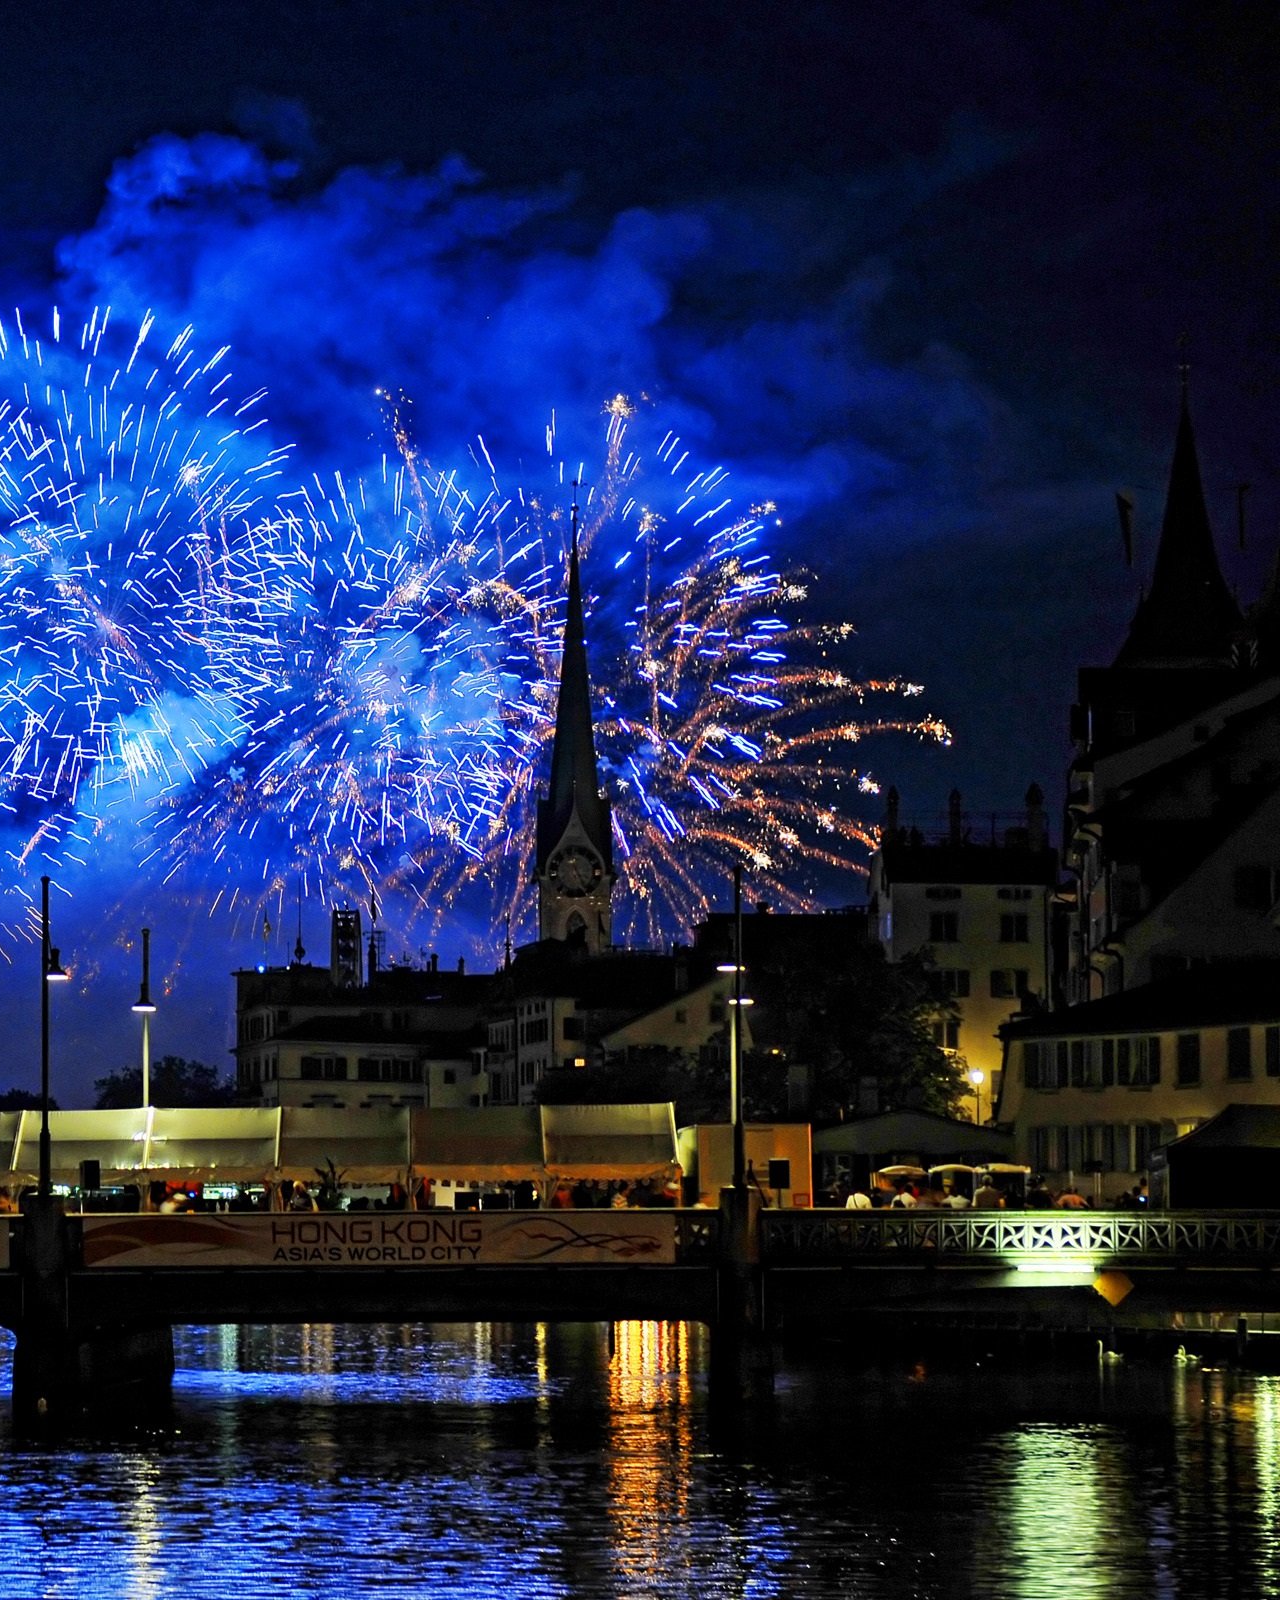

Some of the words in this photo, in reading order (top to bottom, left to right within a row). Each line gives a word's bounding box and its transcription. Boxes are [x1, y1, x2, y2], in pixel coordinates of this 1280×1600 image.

[273, 1221, 372, 1244] HONG
[382, 1220, 482, 1243] KONG
[273, 1246, 342, 1261] ASIA'S
[349, 1246, 425, 1261] WORLD
[431, 1246, 482, 1260] CITY
